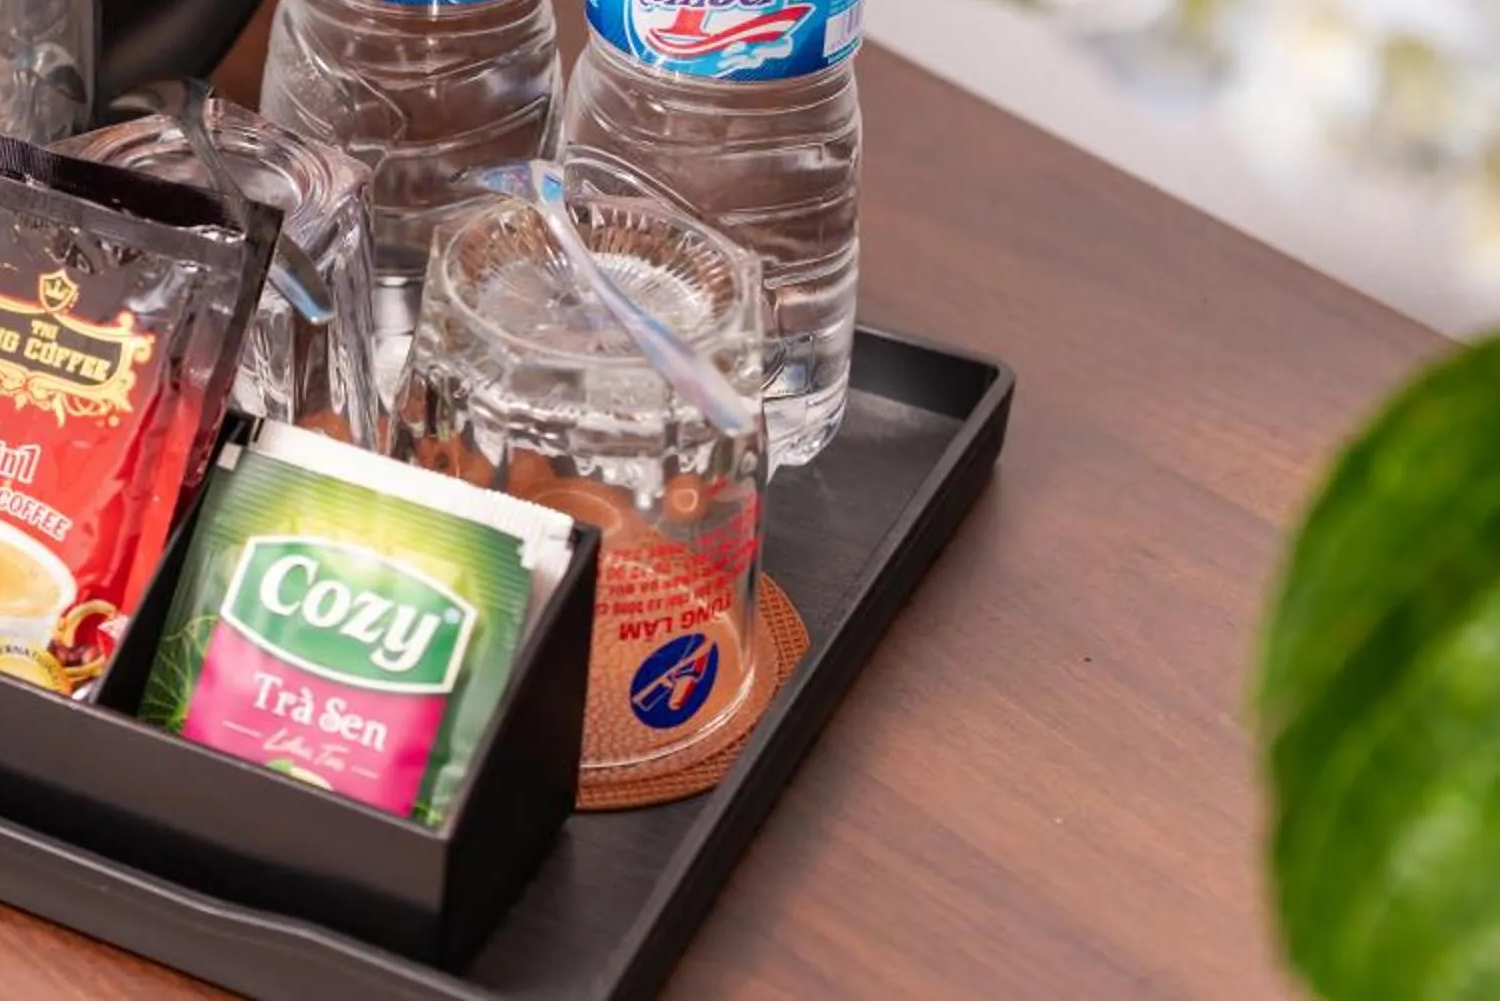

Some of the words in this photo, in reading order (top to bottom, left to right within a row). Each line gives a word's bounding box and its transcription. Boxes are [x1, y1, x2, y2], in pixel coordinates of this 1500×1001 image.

[23, 336, 112, 382] COFFEE
[258, 554, 443, 672] Cozy
[252, 671, 314, 725] Trà
[318, 696, 388, 753] Sen
